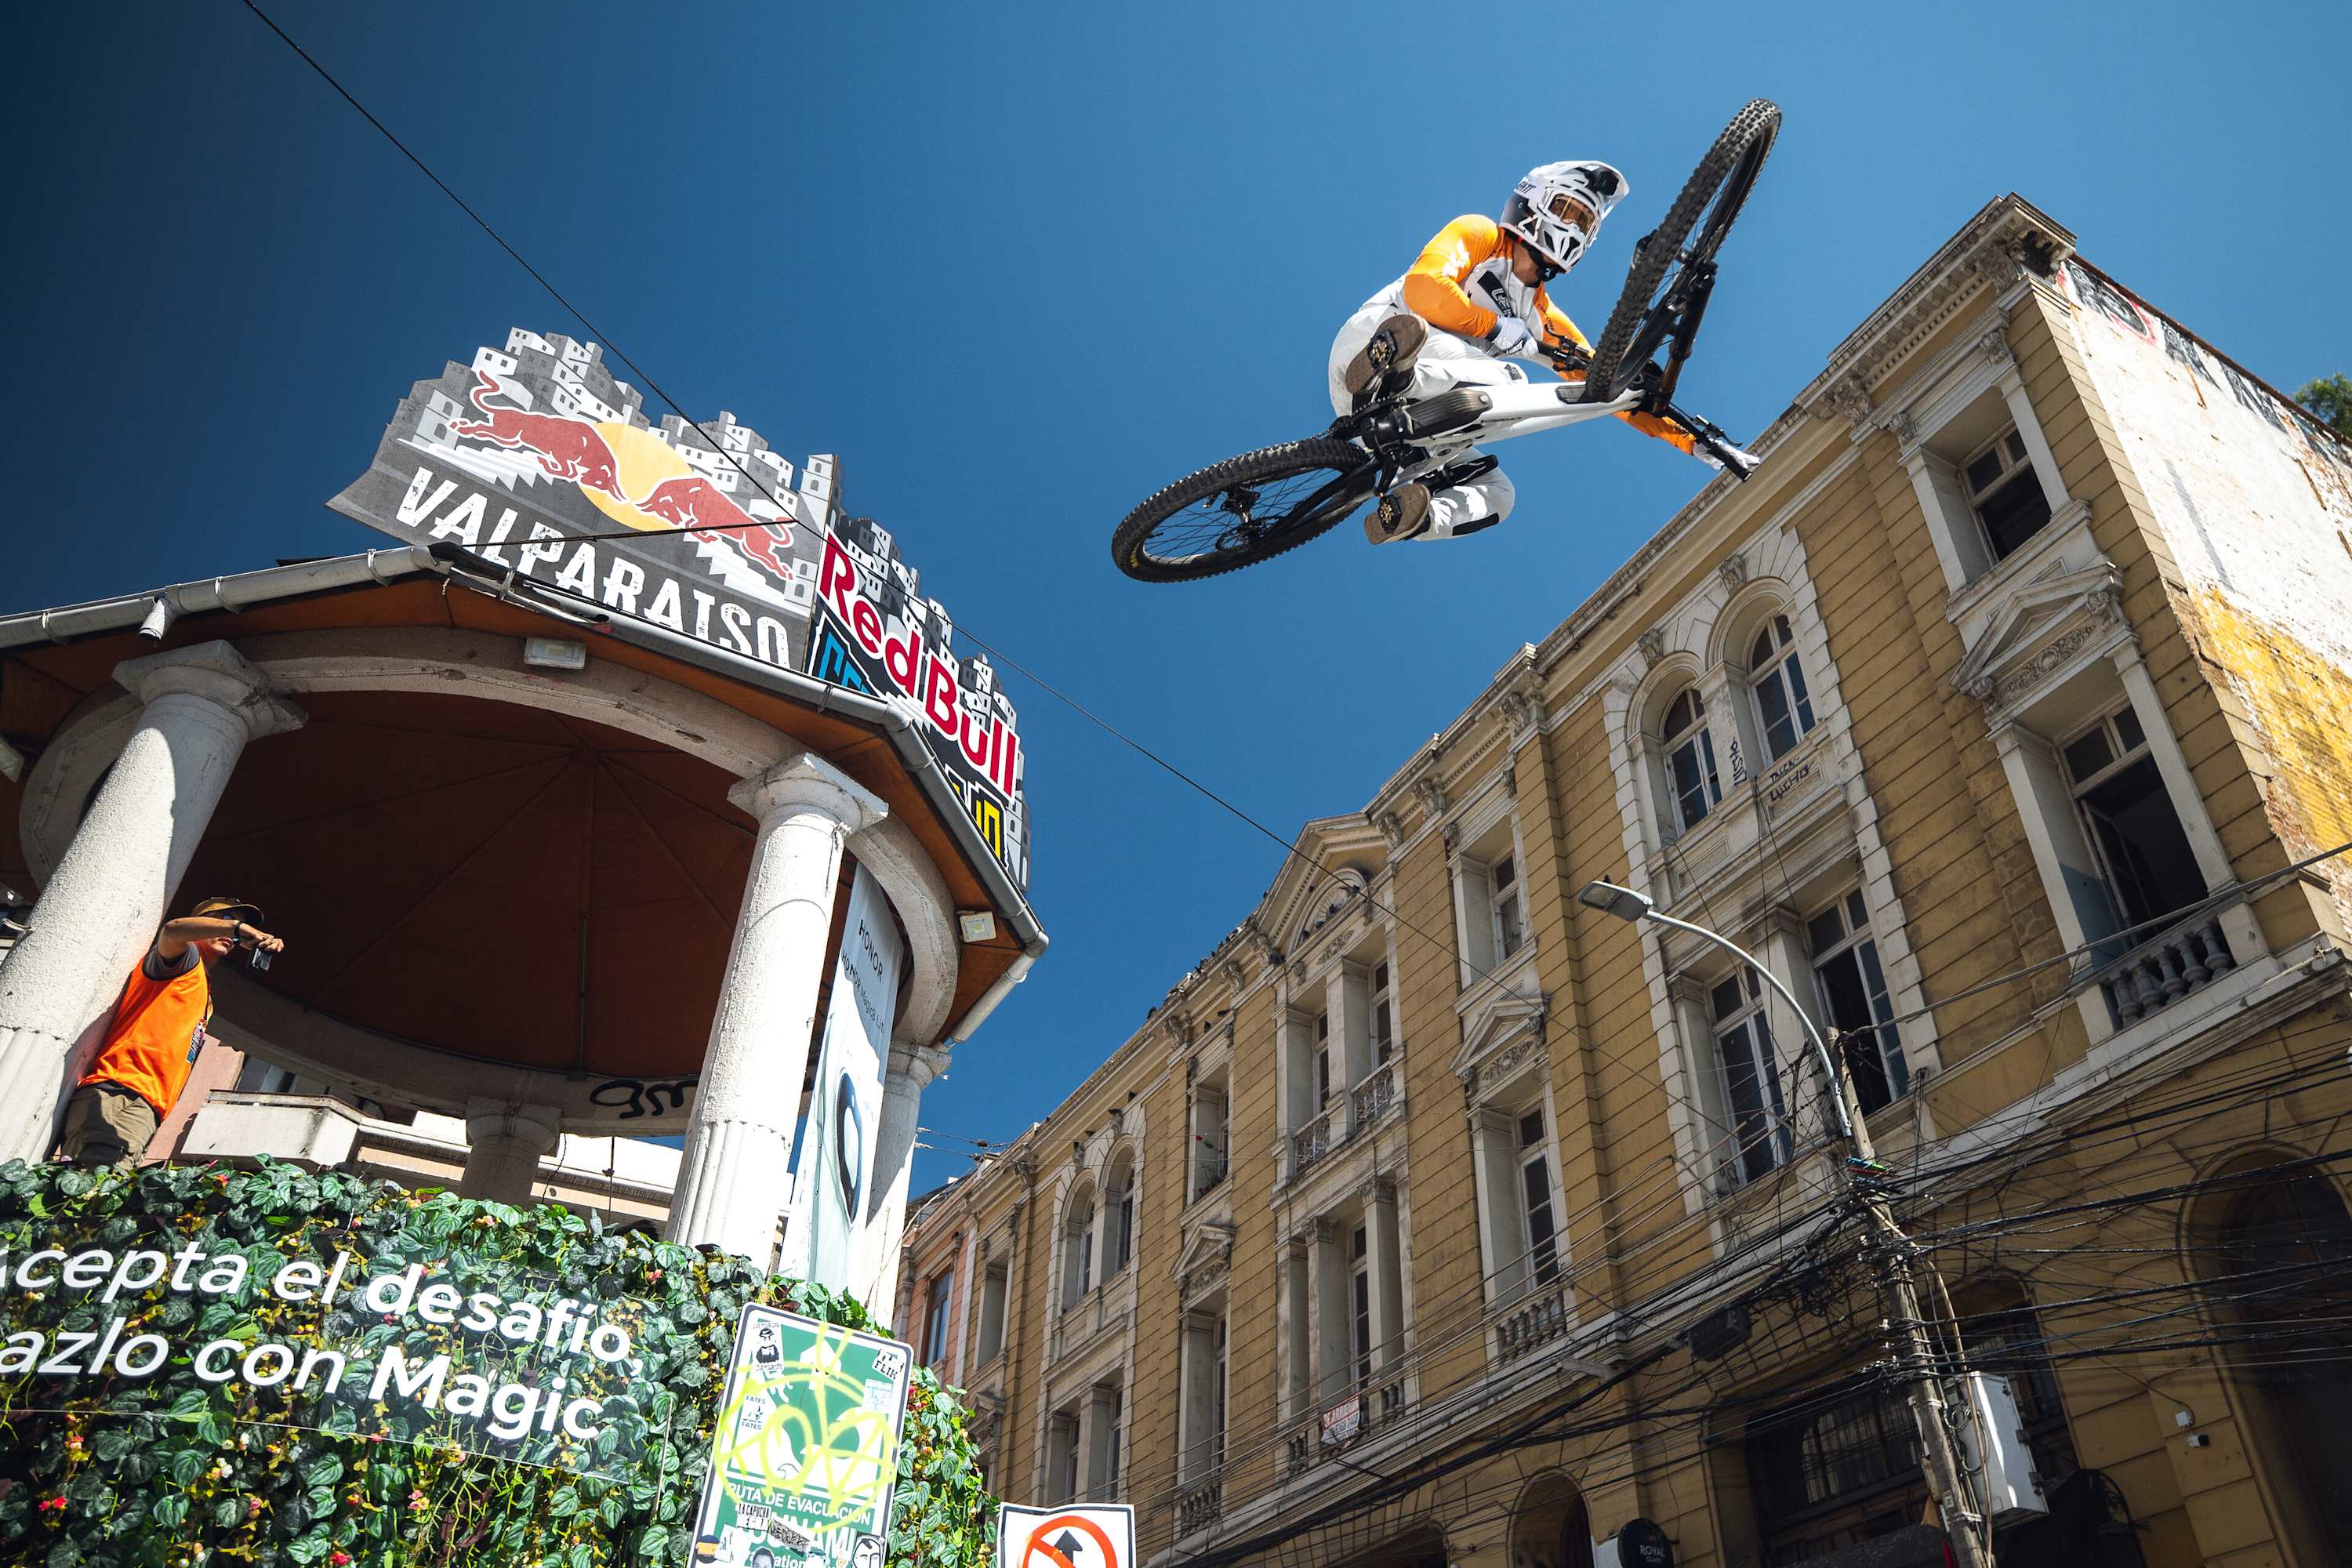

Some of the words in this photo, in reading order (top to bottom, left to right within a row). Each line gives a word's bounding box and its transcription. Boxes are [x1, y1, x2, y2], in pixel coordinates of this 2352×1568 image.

[396, 466, 790, 669] VALPARAISO
[818, 533, 922, 701] Red
[924, 657, 1017, 800] Bull
[842, 950, 861, 992] HONOR
[858, 919, 883, 982] HONOR
[0, 1241, 249, 1304] cepta
[274, 1251, 350, 1305] el
[365, 1263, 643, 1377] desafío,
[194, 1338, 347, 1395] con
[368, 1345, 604, 1440] Magic
[746, 1395, 766, 1404] FATES
[742, 1421, 763, 1431] FATES
[746, 1504, 770, 1519] CAPUCHA
[765, 1491, 785, 1508] DE
[1639, 1544, 1666, 1558] ROYAL
